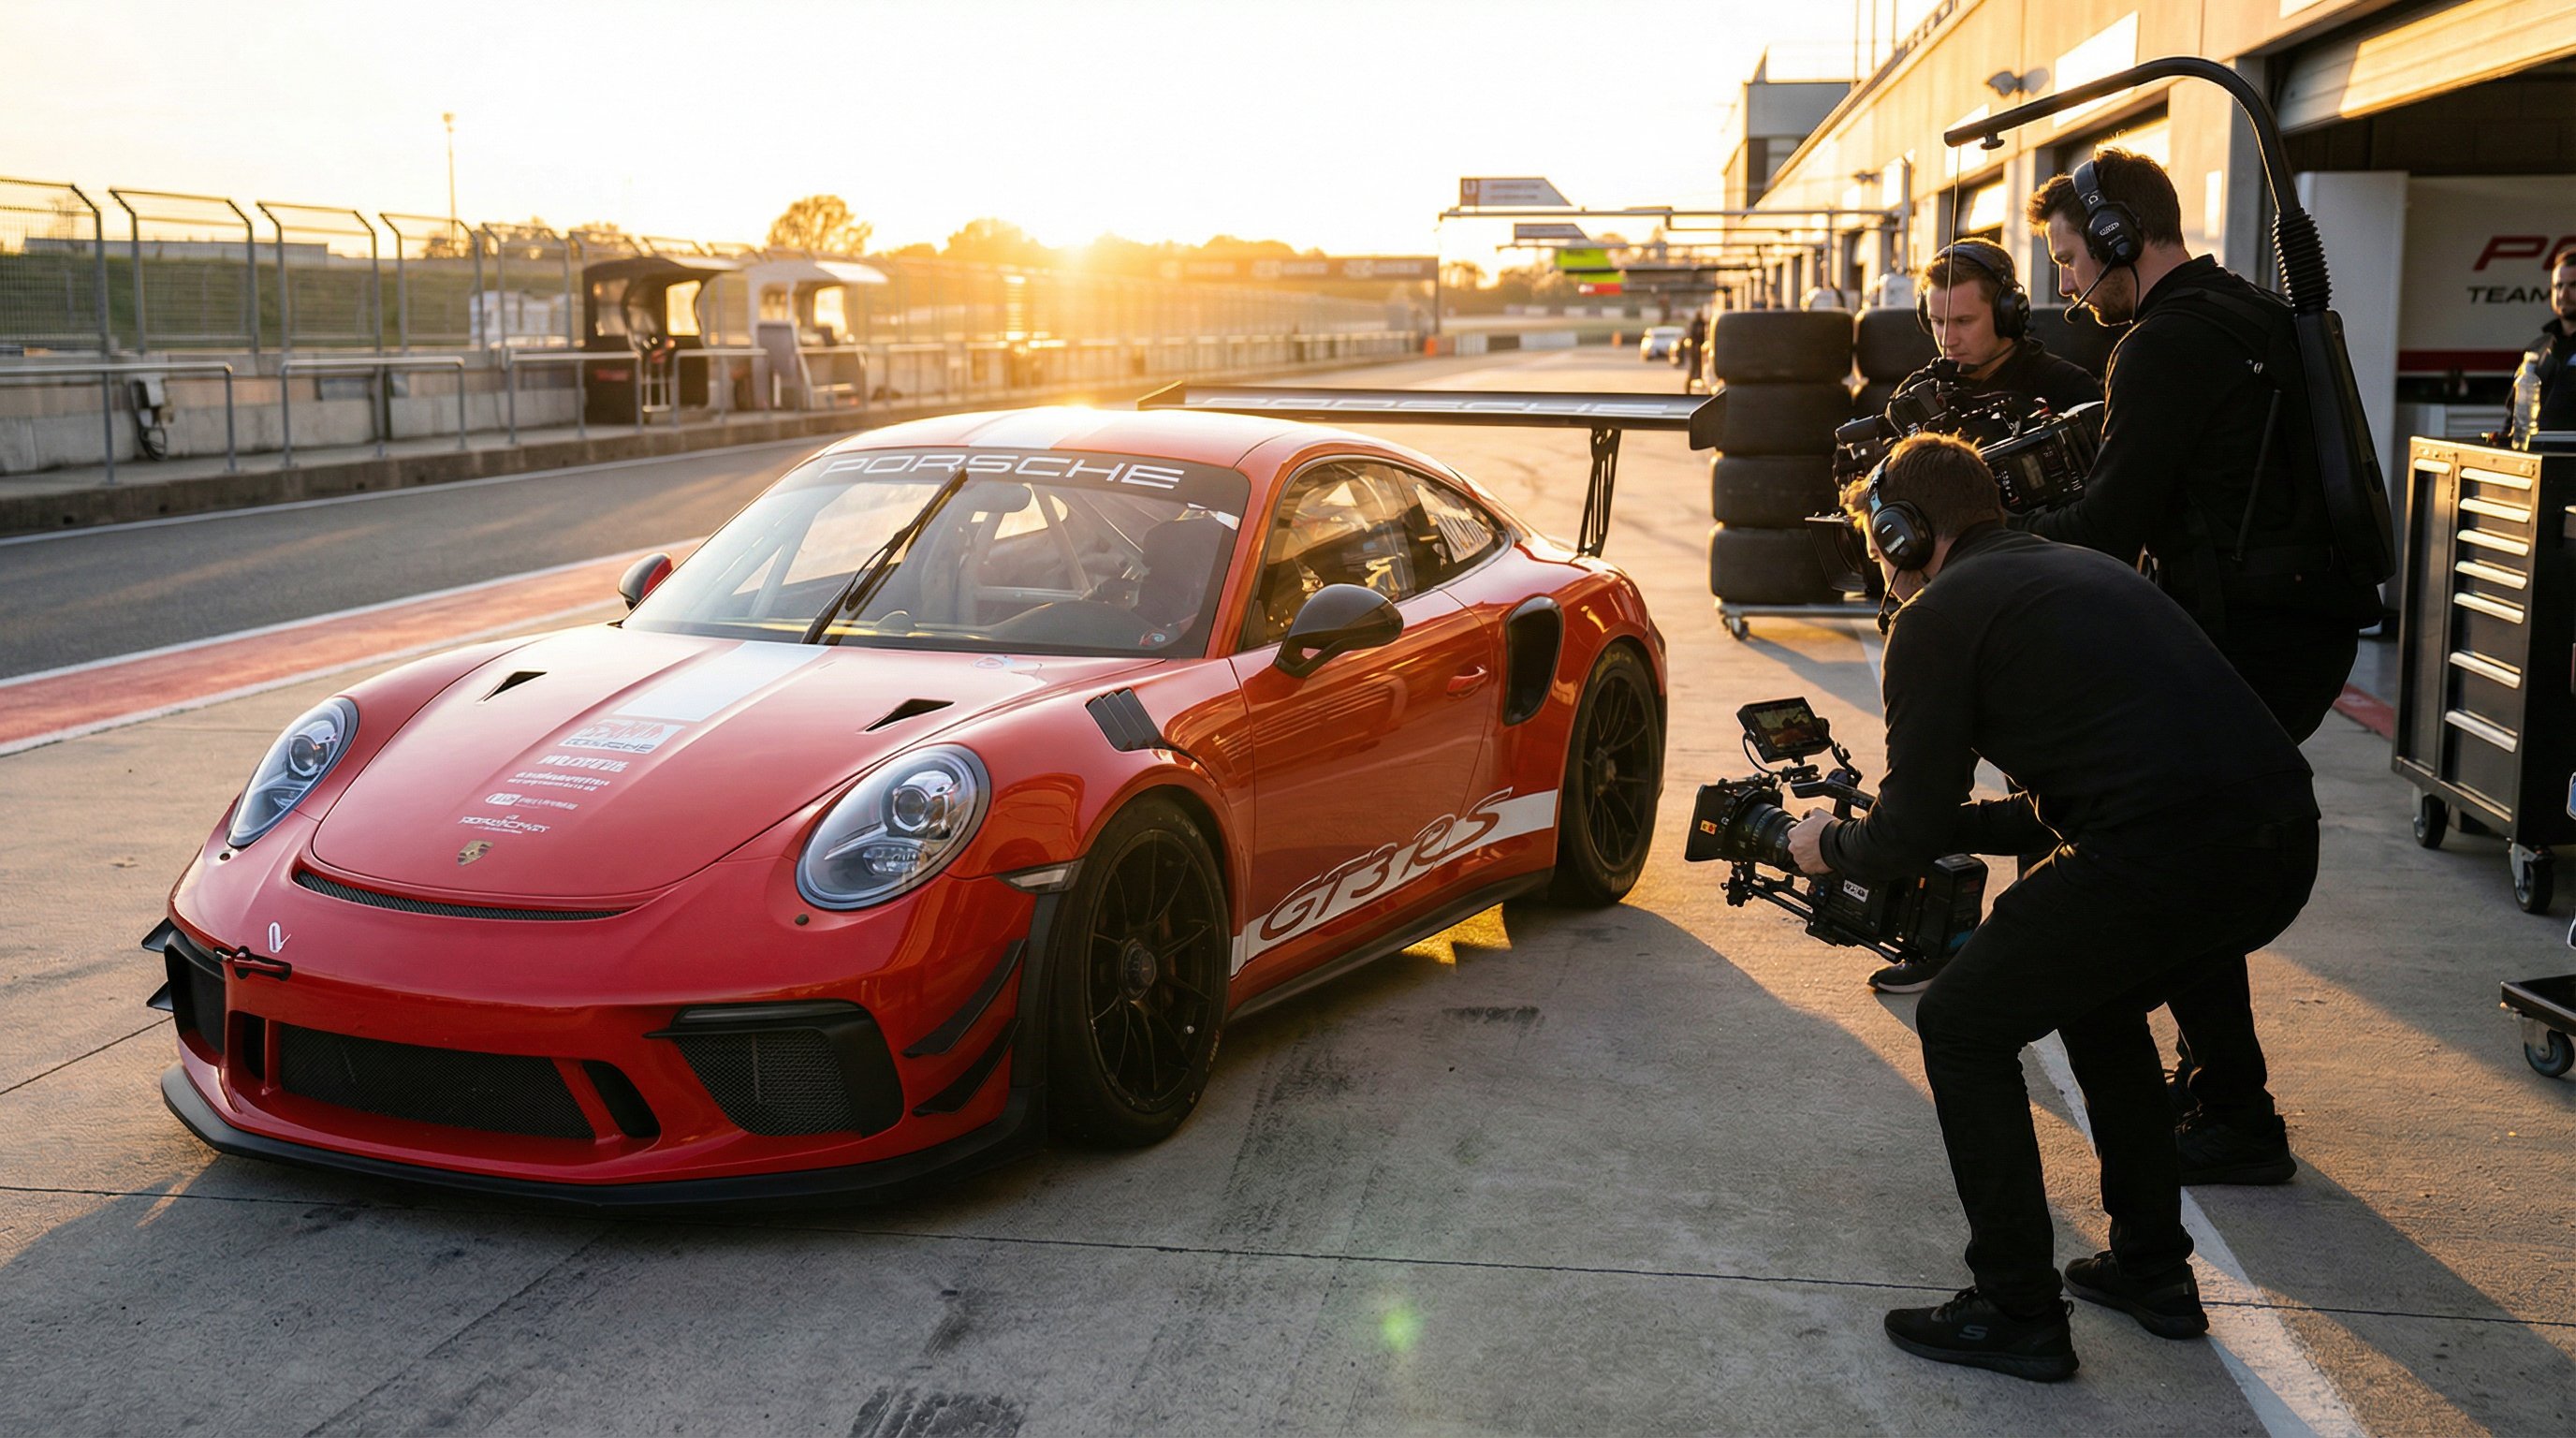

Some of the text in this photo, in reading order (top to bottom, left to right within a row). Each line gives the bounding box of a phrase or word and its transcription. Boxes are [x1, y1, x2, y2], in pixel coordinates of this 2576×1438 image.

[2467, 286, 2552, 303] TEAM
[818, 454, 1185, 490] PORSCHE
[1260, 786, 1514, 941] GT3 RS
